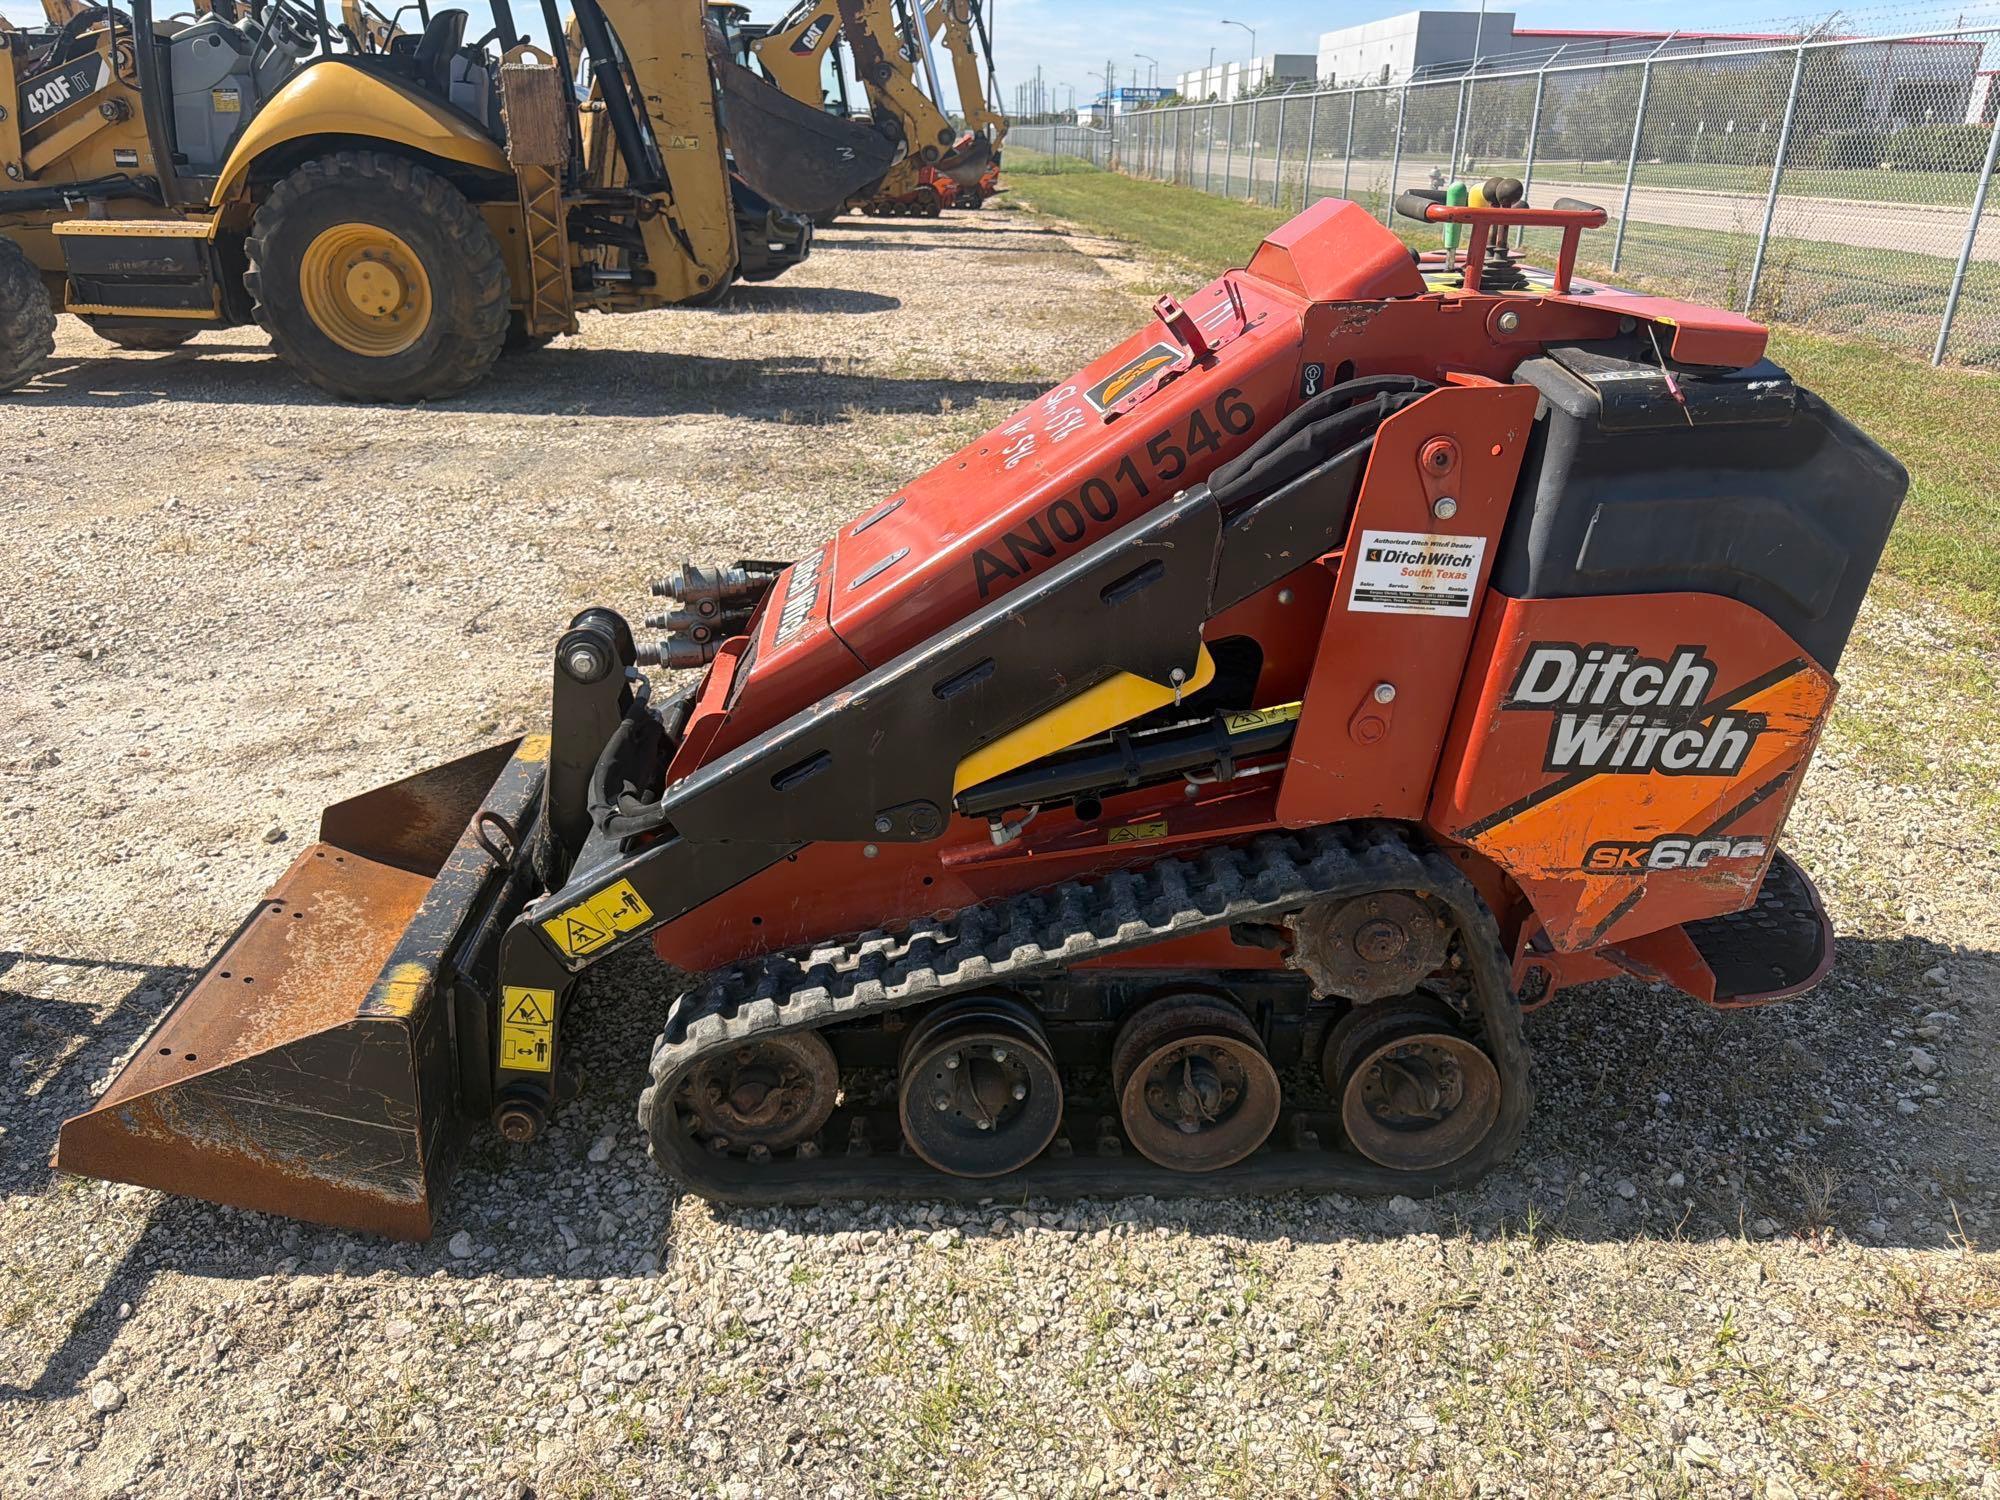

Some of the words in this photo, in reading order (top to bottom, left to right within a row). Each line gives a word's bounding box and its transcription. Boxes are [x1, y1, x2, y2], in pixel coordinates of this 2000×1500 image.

[802, 23, 823, 50] CAT
[27, 75, 71, 114] 420F
[70, 70, 90, 92] IT
[1043, 406, 1087, 444] 1546
[1001, 434, 1037, 471] 546
[971, 387, 1256, 599] AN001546
[1373, 538, 1410, 547] Authorized
[1411, 540, 1429, 548] Ditch
[1450, 542, 1473, 550] Dealer
[1401, 567, 1432, 578] South
[1437, 568, 1468, 580] Texas
[1513, 649, 1710, 707] Ditch
[1551, 713, 1749, 769] Witch
